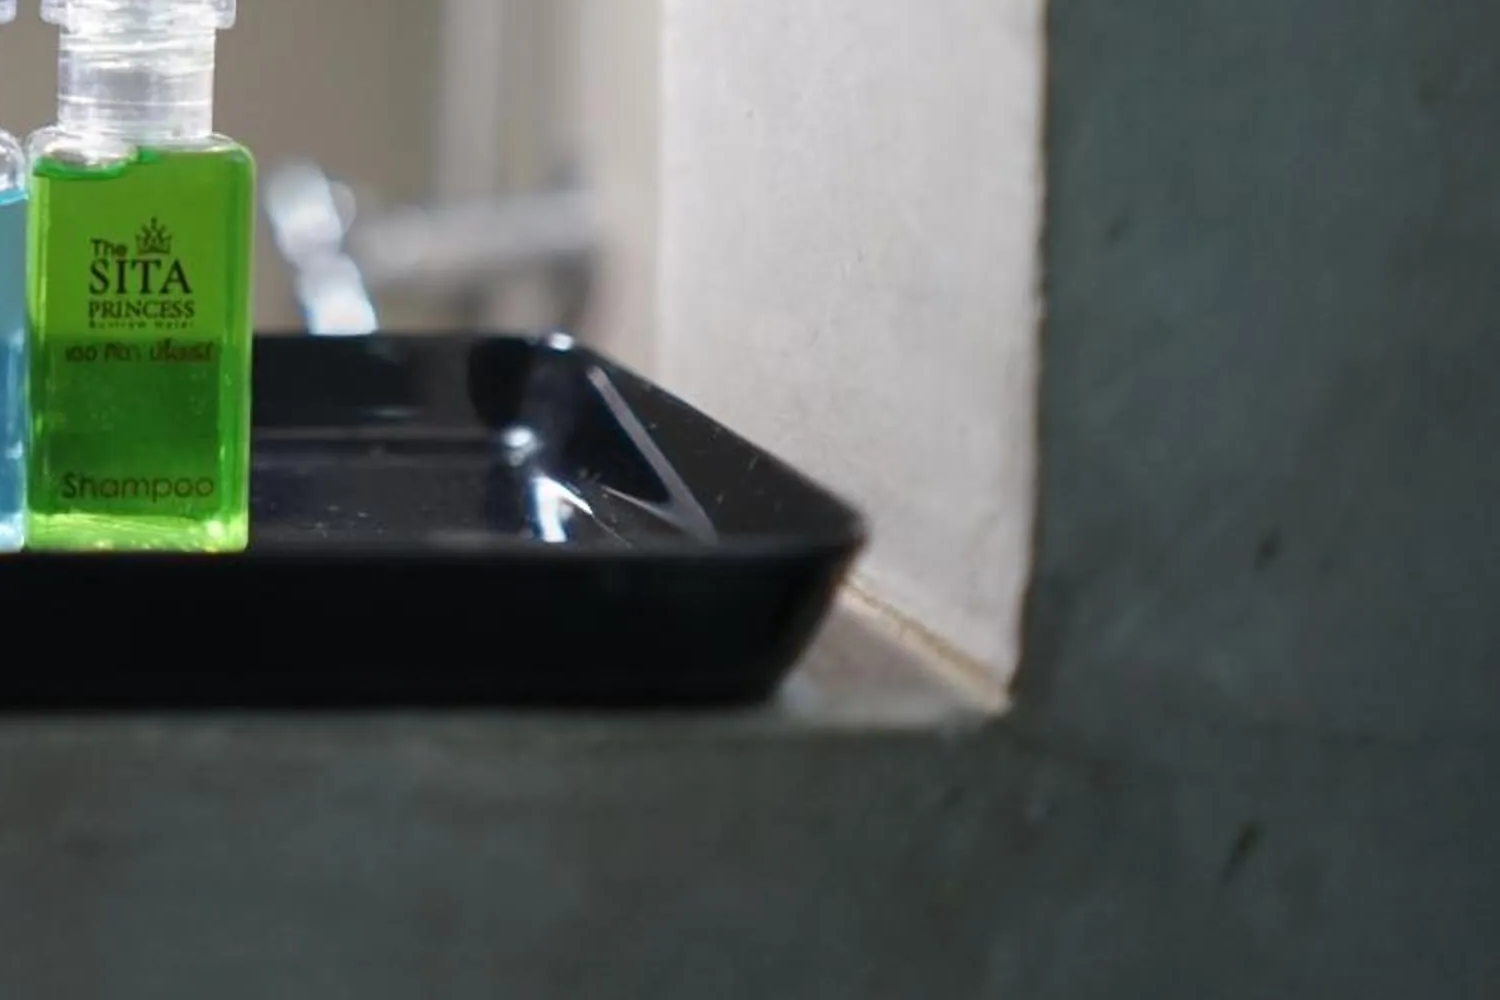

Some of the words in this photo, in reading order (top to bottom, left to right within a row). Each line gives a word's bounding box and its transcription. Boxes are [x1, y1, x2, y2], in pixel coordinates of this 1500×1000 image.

[90, 237, 128, 258] The
[88, 258, 193, 295] SITA
[88, 299, 195, 319] PRINCESS
[61, 471, 214, 504] Shampoo
